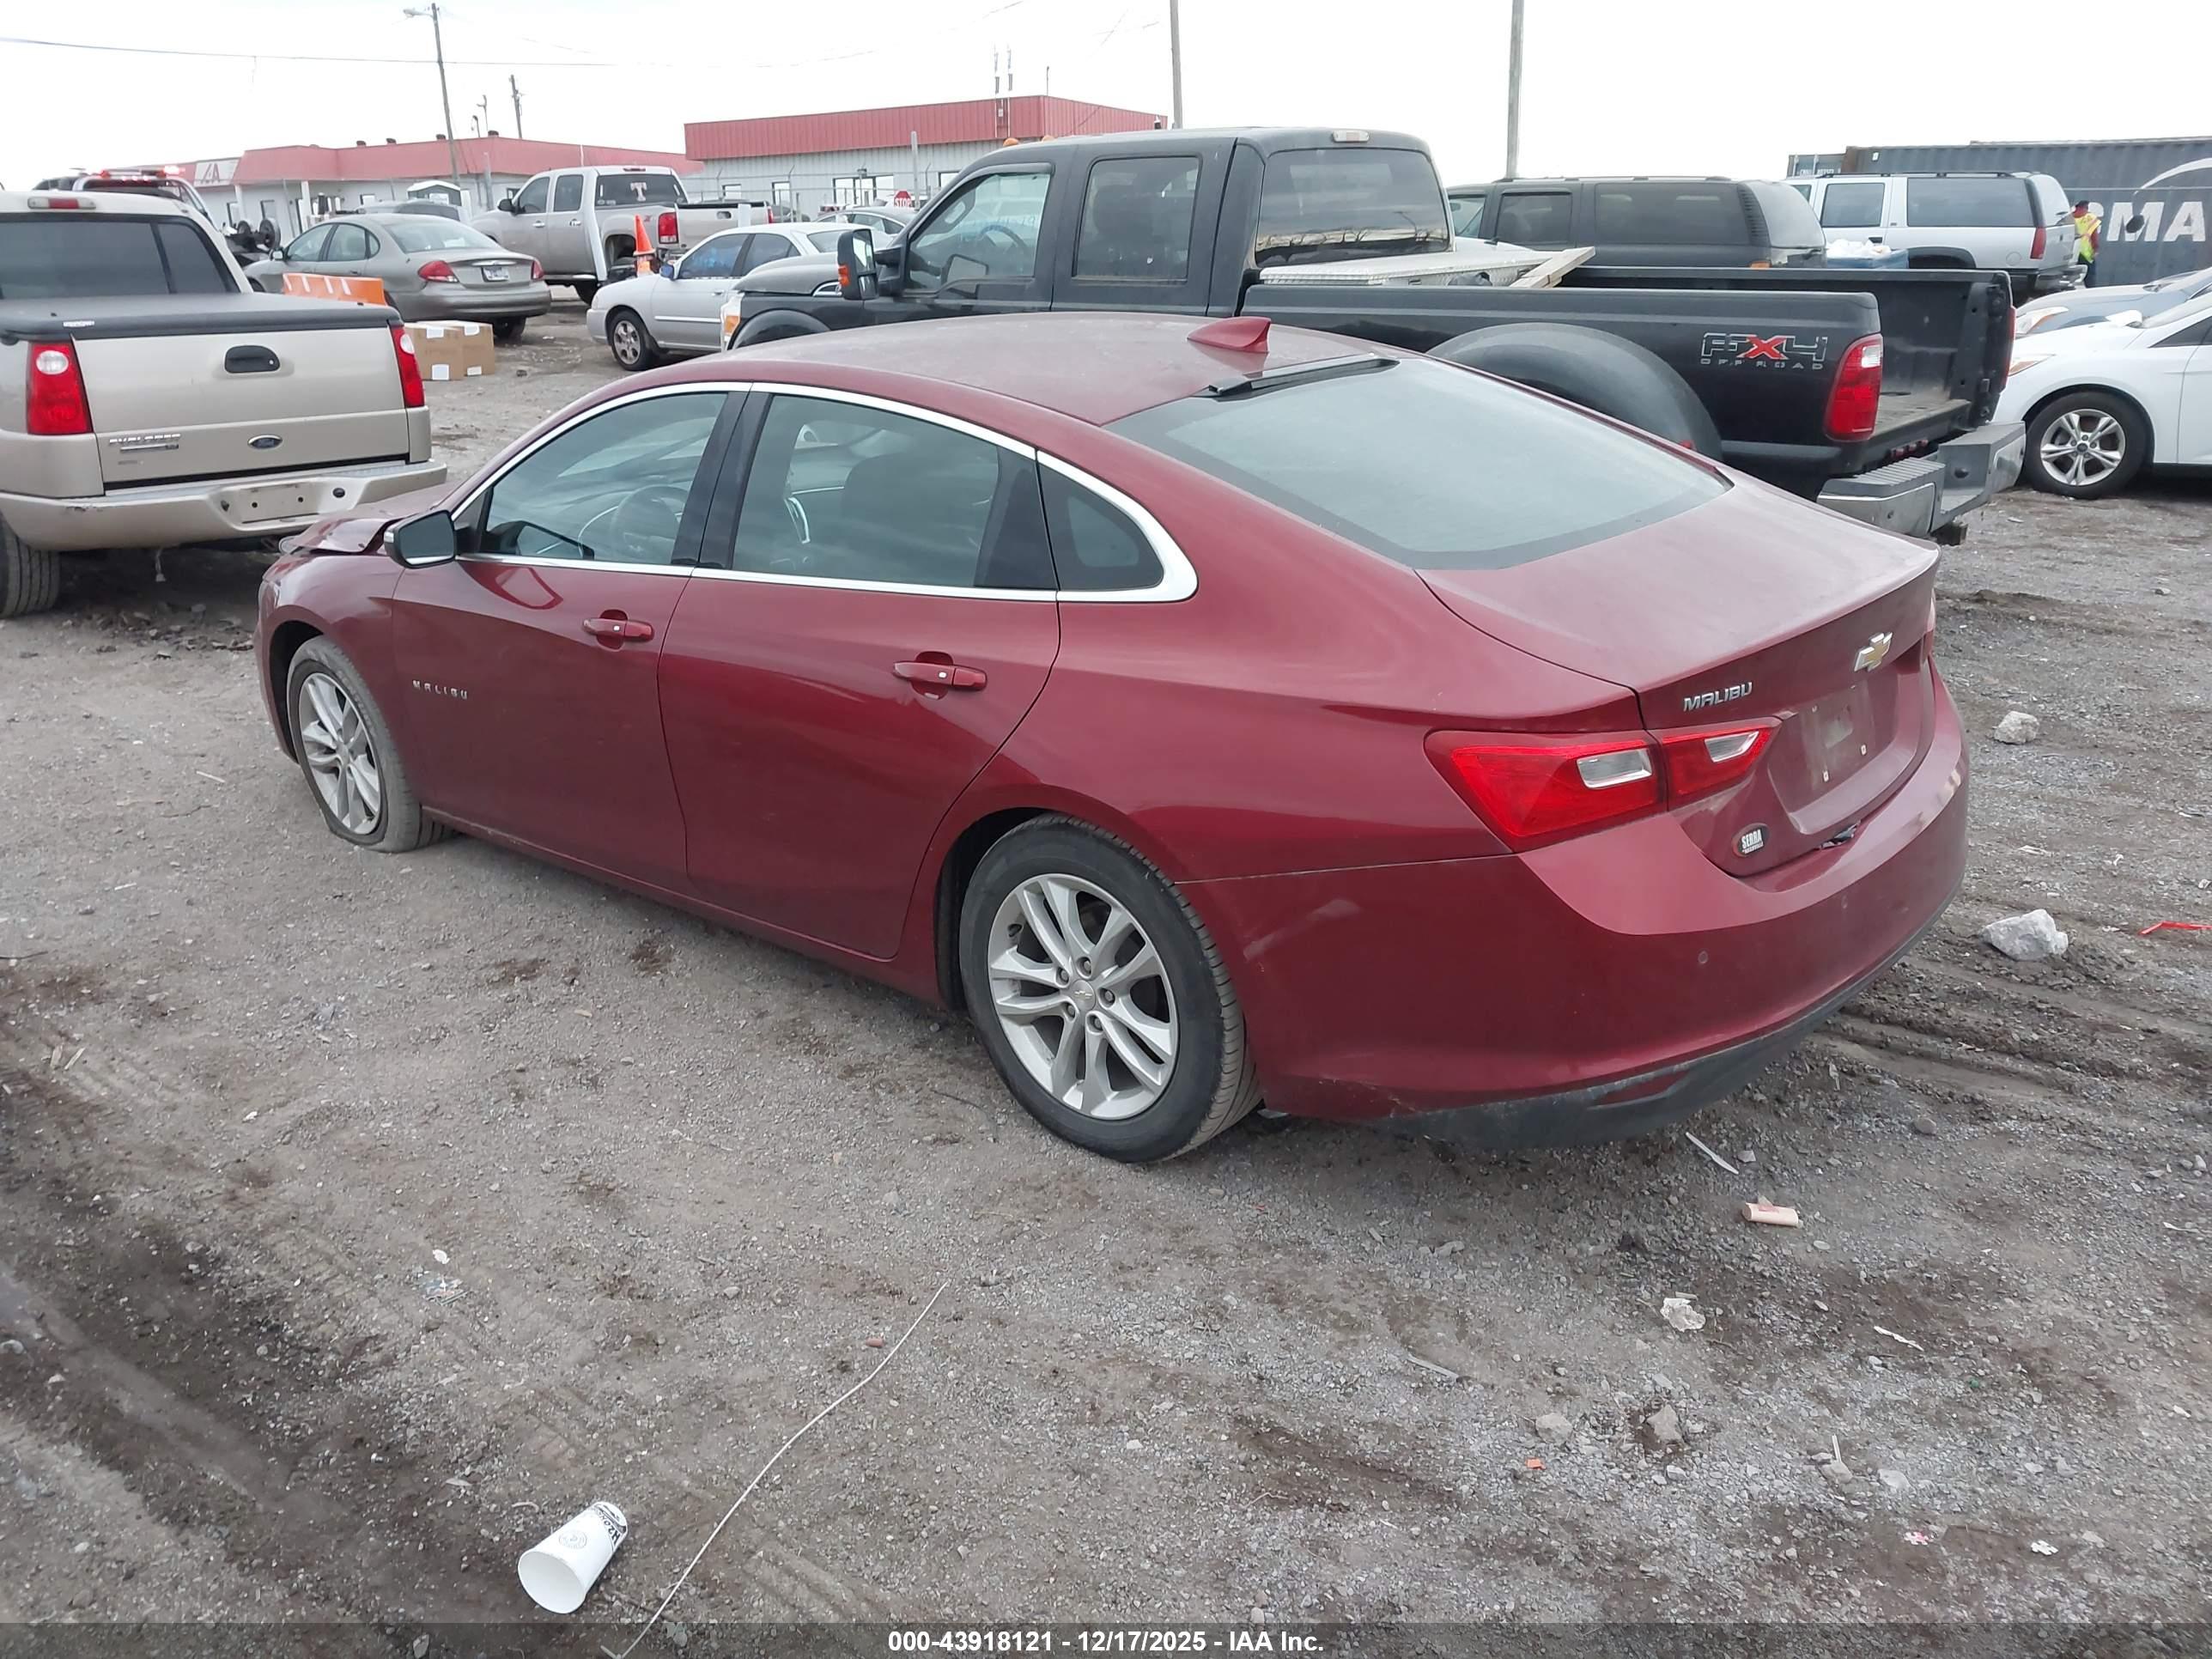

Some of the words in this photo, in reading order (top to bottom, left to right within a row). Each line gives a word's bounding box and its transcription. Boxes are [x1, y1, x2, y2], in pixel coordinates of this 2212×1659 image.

[895, 198, 912, 207] STOP
[1701, 332, 1828, 362] FX4
[1756, 361, 1823, 369] ROAD
[412, 680, 467, 700] MALIBU
[1683, 682, 1752, 712] MALIBU
